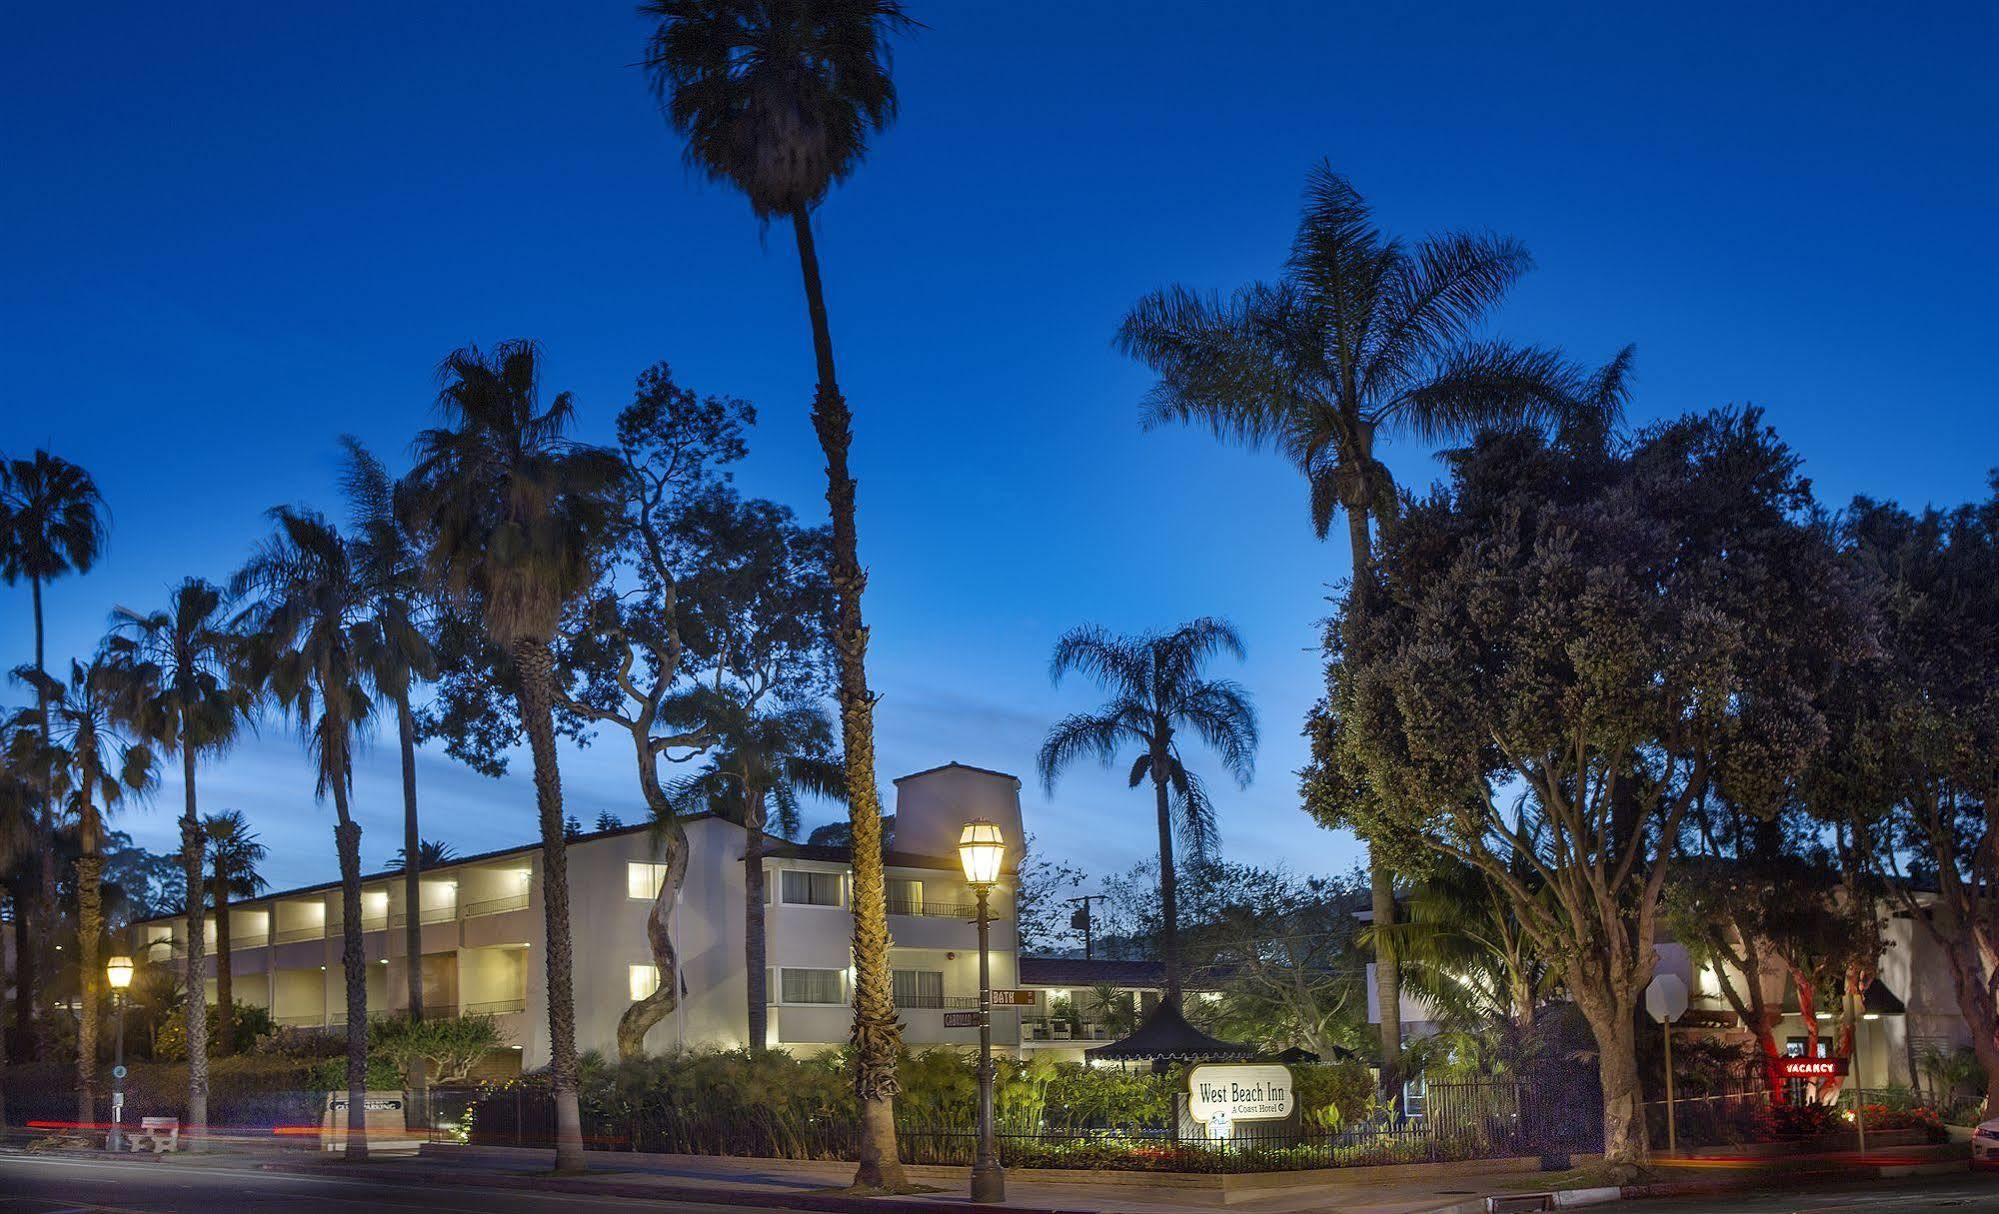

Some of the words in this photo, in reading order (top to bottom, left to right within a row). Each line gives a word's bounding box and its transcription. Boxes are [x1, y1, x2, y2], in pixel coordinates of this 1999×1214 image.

[993, 991, 1015, 1004] BATH
[1786, 1063, 1834, 1073] VACANCY
[1200, 1083, 1227, 1103] West
[1231, 1082, 1264, 1103] Beach
[1267, 1082, 1285, 1101] Inn
[1232, 1106, 1237, 1114] A
[1238, 1104, 1258, 1114] Coast
[1259, 1103, 1277, 1113] Hotel
